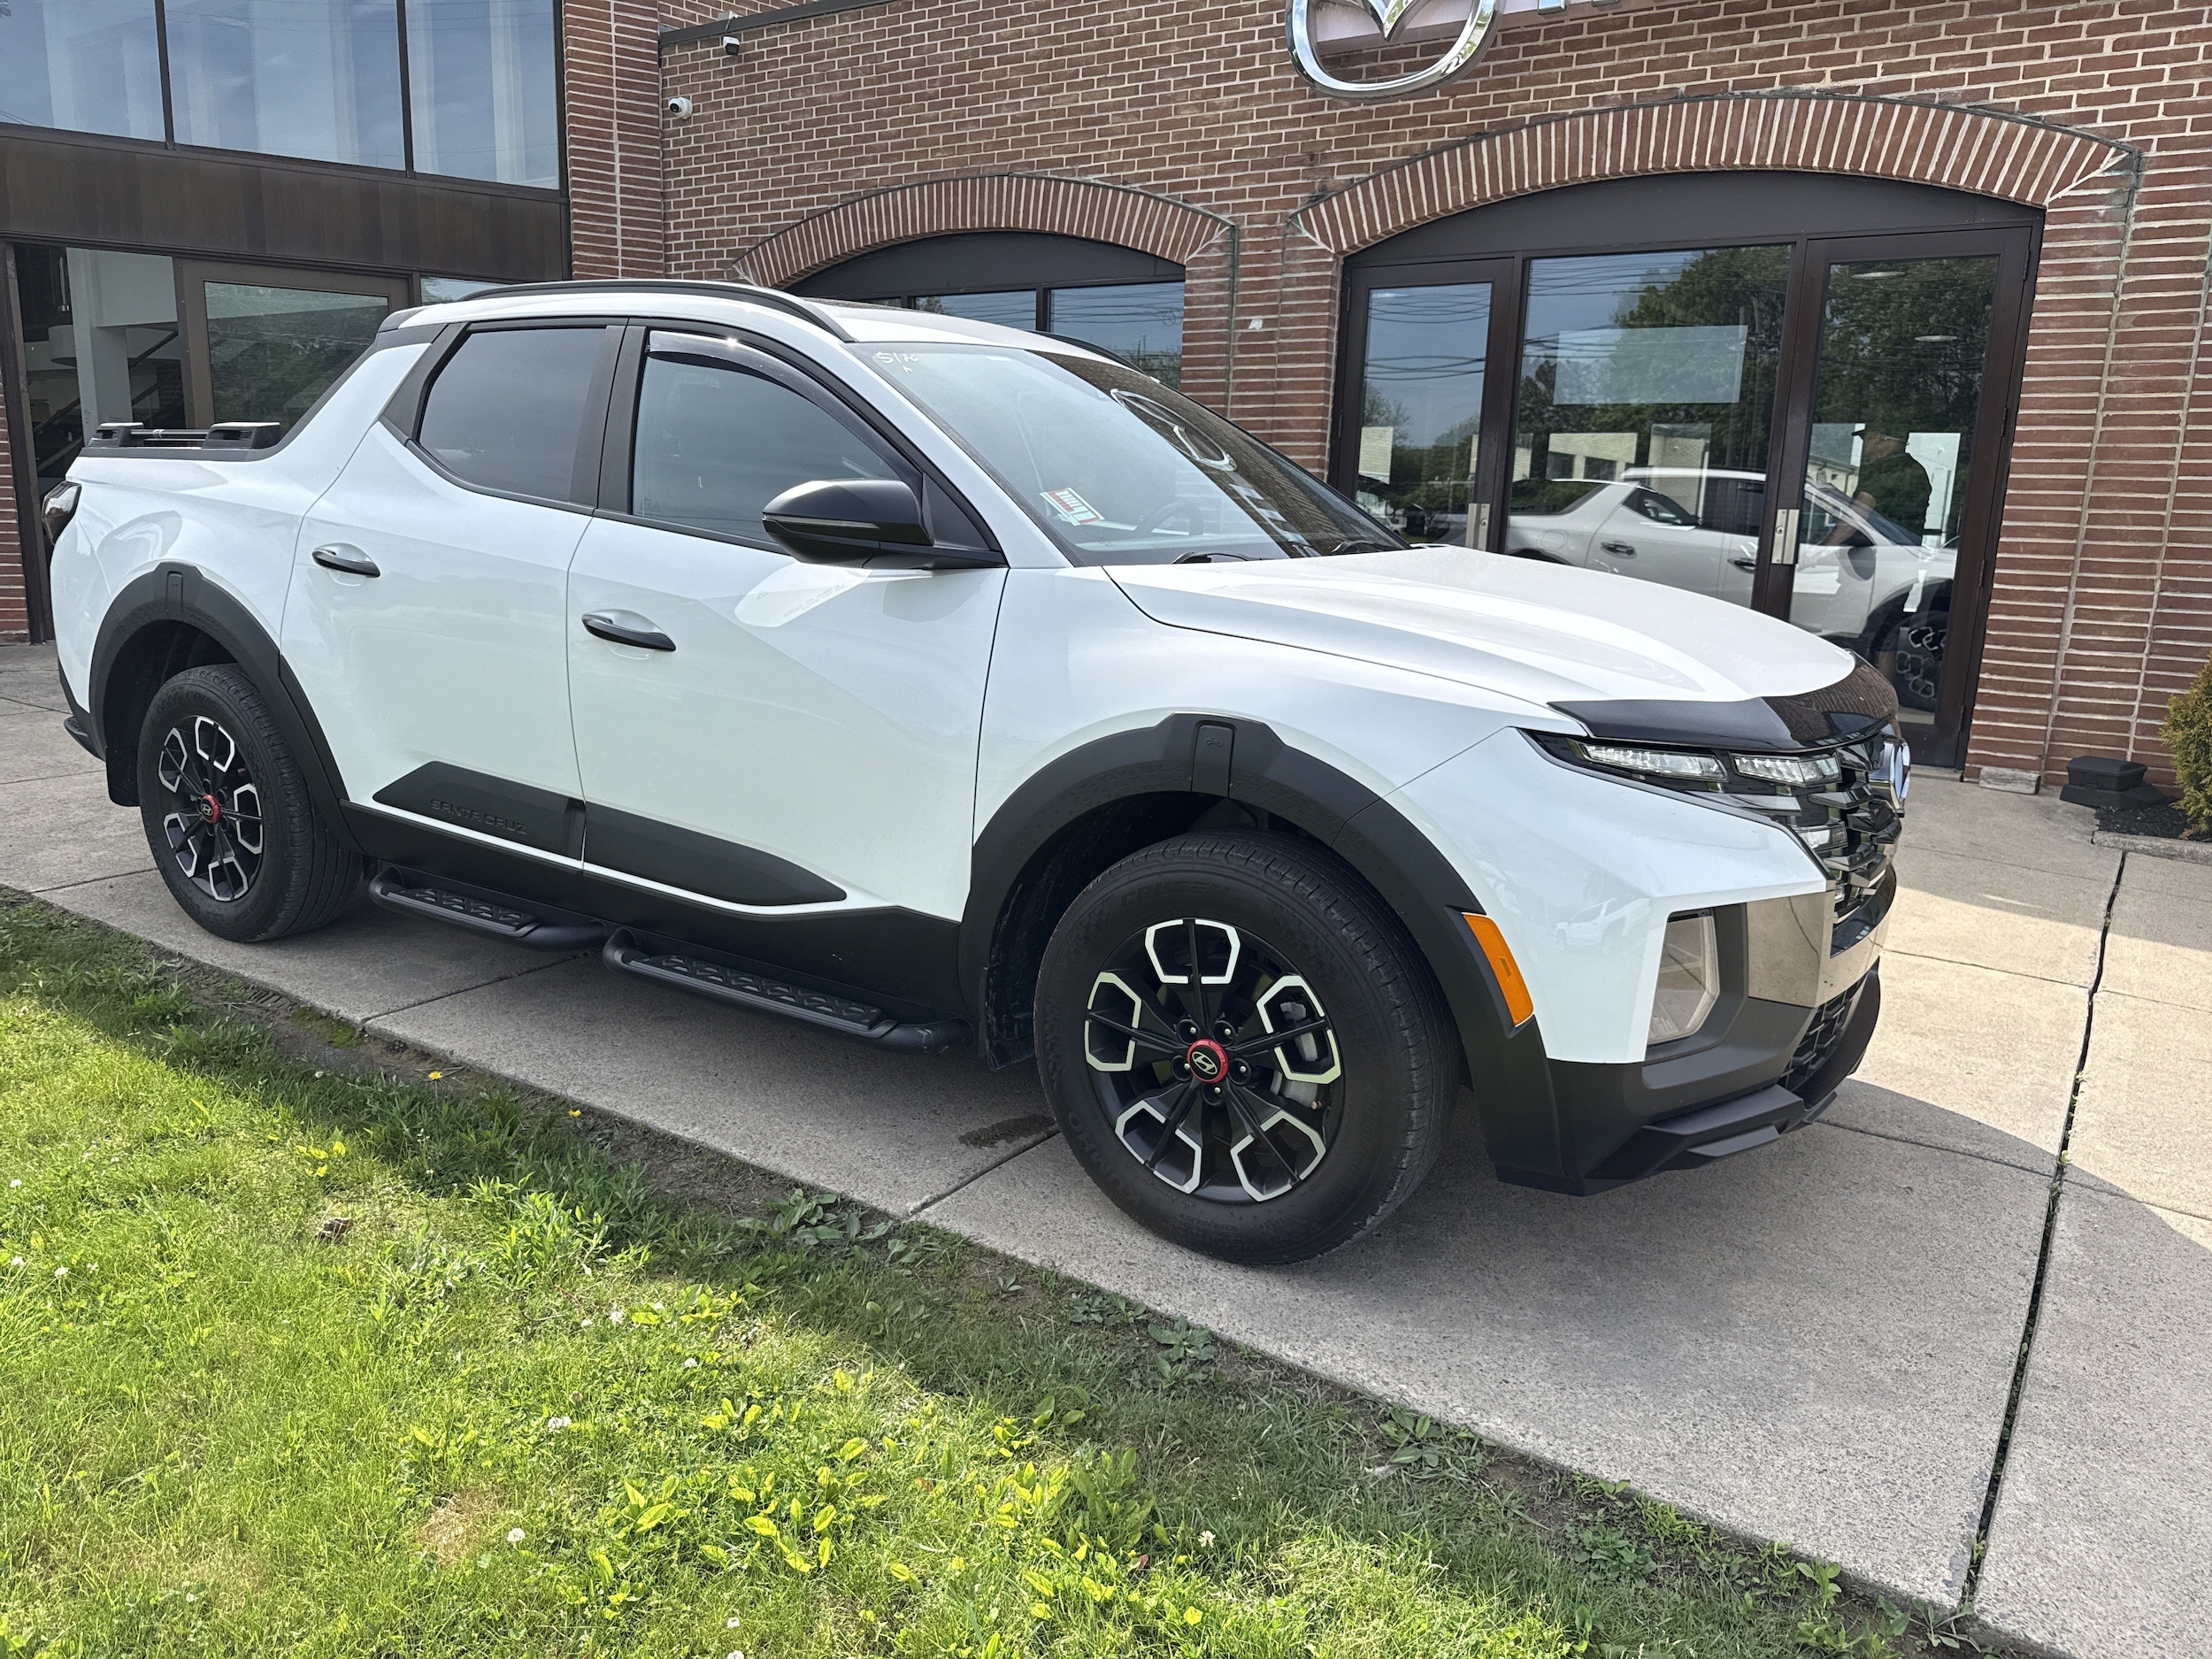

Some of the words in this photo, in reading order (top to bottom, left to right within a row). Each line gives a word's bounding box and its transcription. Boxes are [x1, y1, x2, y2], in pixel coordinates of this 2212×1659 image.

[430, 798, 481, 823] SANTA
[485, 813, 527, 835] CRUZ
[1119, 879, 1233, 909] CRUGEN
[1067, 1110, 1142, 1204] KUMHO
